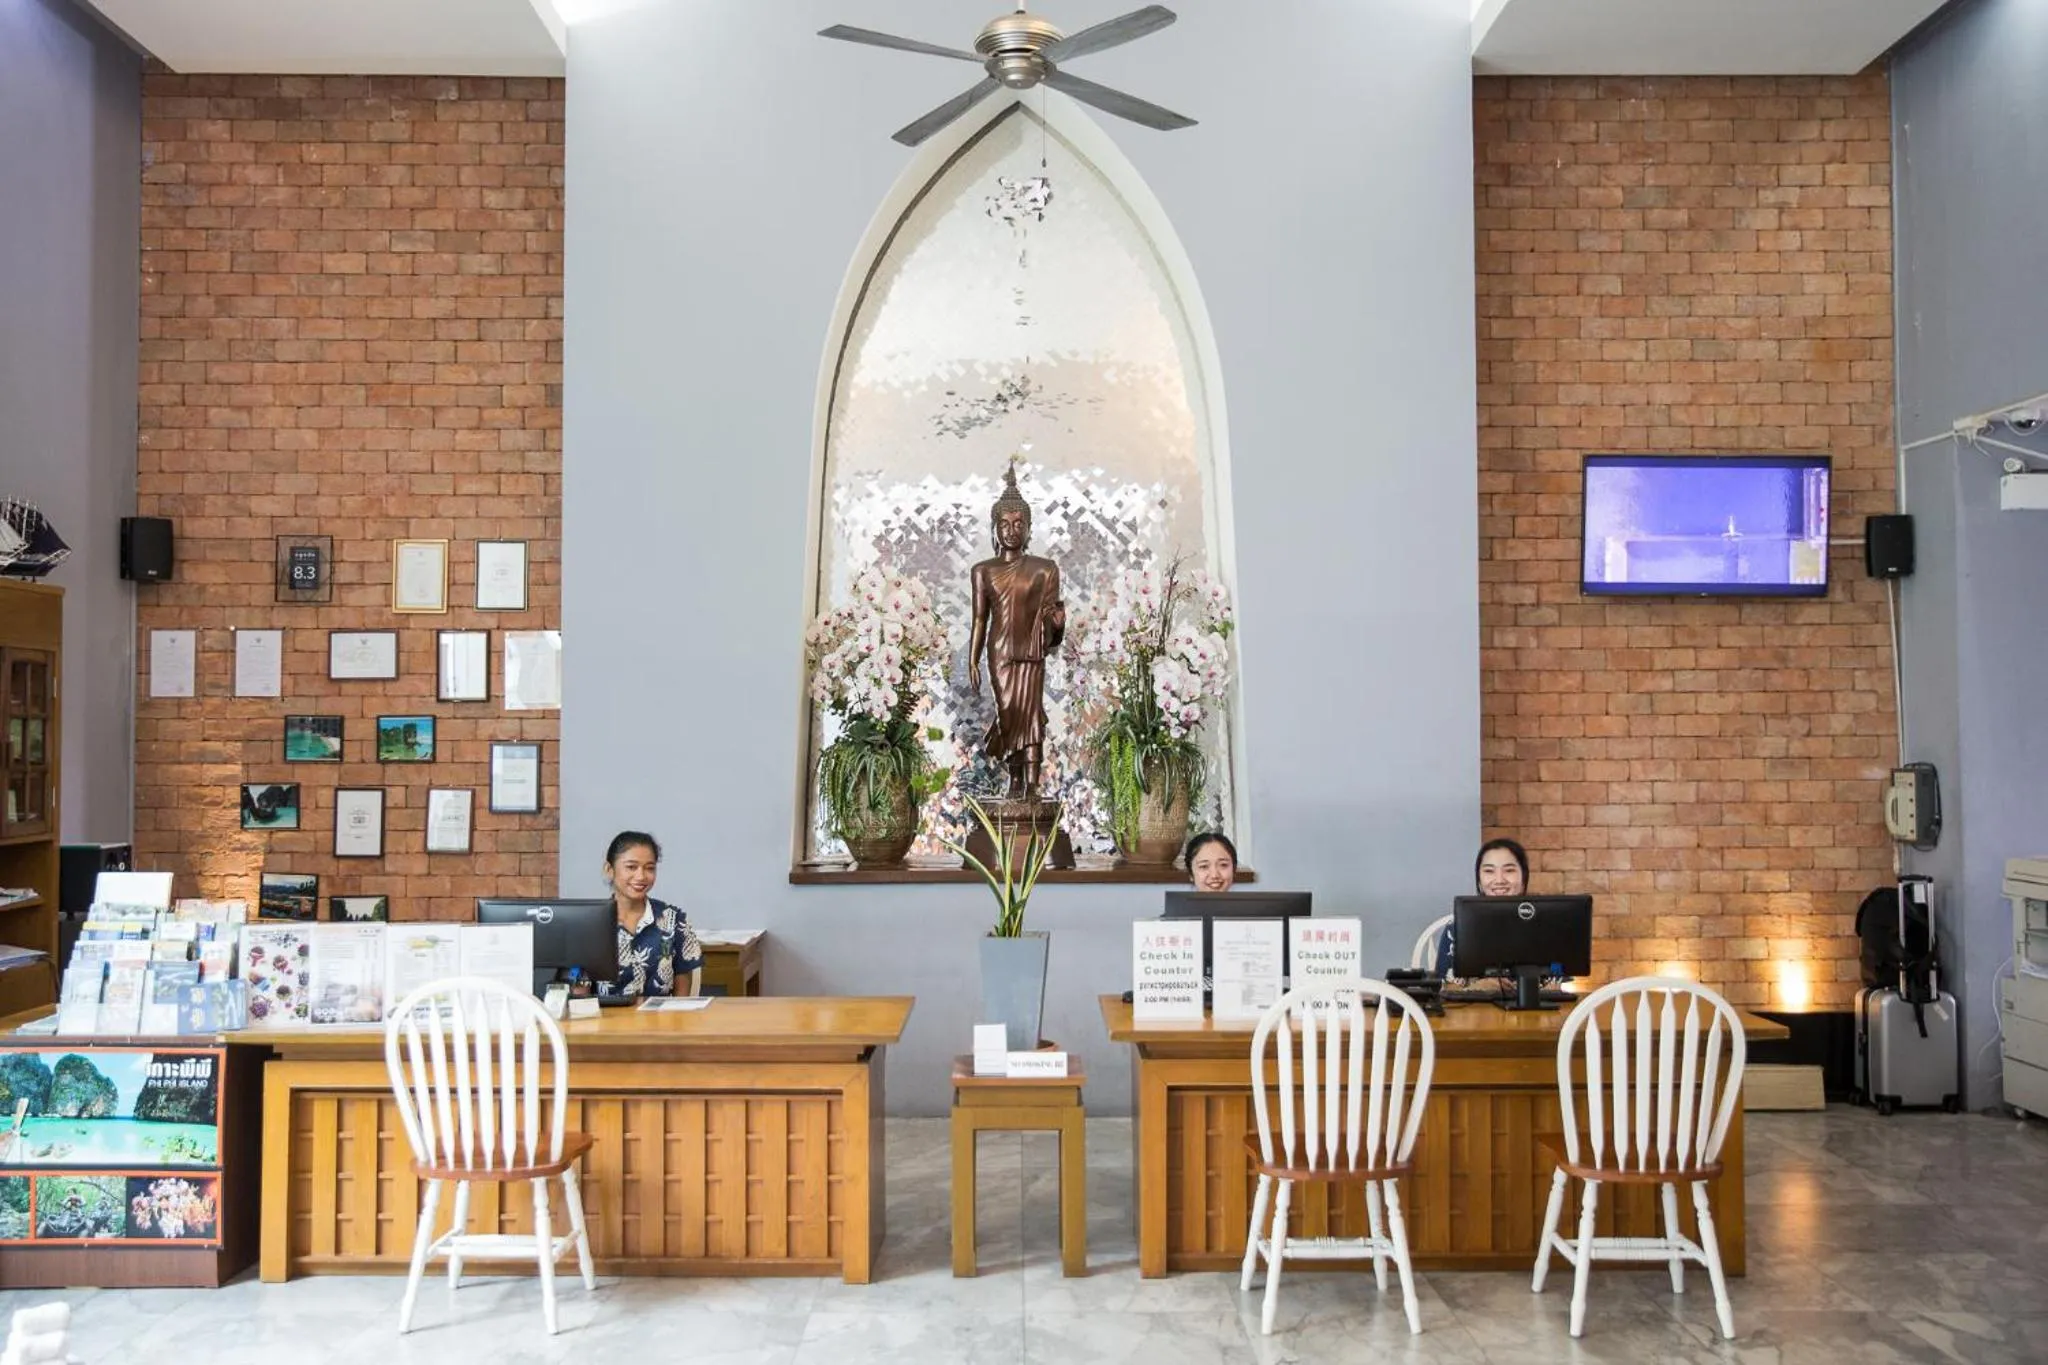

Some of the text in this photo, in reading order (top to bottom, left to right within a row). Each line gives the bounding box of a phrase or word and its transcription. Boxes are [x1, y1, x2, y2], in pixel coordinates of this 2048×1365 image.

[294, 566, 316, 580] 8.3
[1139, 951, 1194, 961] Check In
[1297, 950, 1357, 961] Check OUT
[1144, 966, 1194, 975] Counter
[1306, 966, 1348, 975] Counter
[144, 1057, 213, 1079] เกาะพีพี
[178, 1079, 209, 1089] ISLAND
